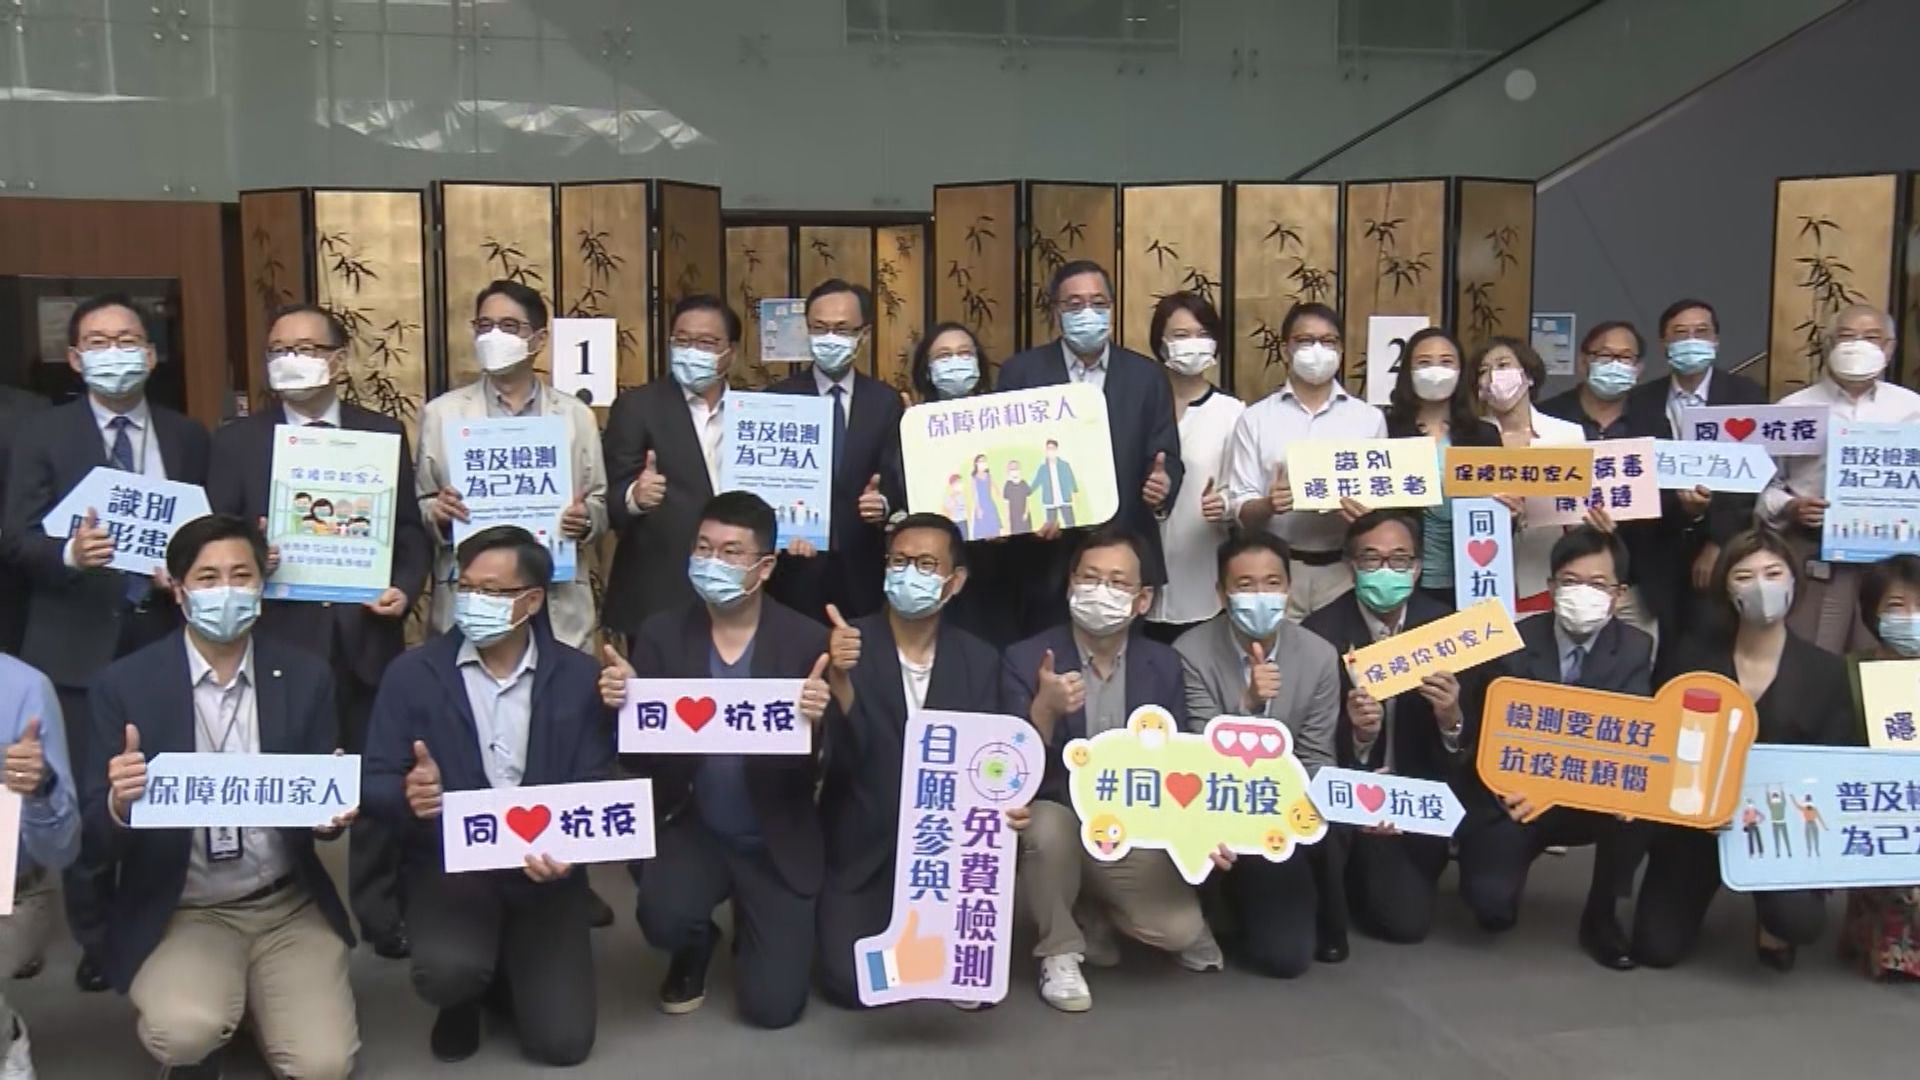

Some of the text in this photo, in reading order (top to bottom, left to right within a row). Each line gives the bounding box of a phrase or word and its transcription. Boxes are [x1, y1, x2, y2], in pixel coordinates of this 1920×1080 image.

[575, 340, 594, 375] 1
[1387, 338, 1406, 373] 2
[735, 420, 820, 445] 普及檢測
[927, 396, 1077, 438] 保障你和家人
[1695, 419, 1818, 441] 同 抗疫
[463, 445, 557, 471] 普及檢測
[735, 444, 820, 469] 為己為人
[1335, 450, 1392, 471] 識別
[1454, 463, 1583, 483] 保障你和家人
[1655, 451, 1757, 480] 為己為人
[465, 472, 560, 497] 為己為人
[1304, 474, 1427, 499] 隱形患者
[107, 484, 178, 524] 識別
[69, 513, 168, 560] 形患
[1468, 510, 1495, 537] 同
[1364, 621, 1504, 684] 保障你和家人
[636, 700, 795, 732] 同 抗疫
[1505, 700, 1656, 748] 檢測要做好
[1499, 744, 1649, 793] 抗疫無煩惱
[149, 775, 347, 806] 保障你和家人
[1206, 771, 1283, 816] 抗疫
[1328, 779, 1447, 822] 同 抗疫
[463, 801, 637, 847] 同 抗疫
[908, 723, 959, 902] 自願參與
[1840, 824, 1920, 857] 為己
[951, 806, 1002, 988] 免費檢測
